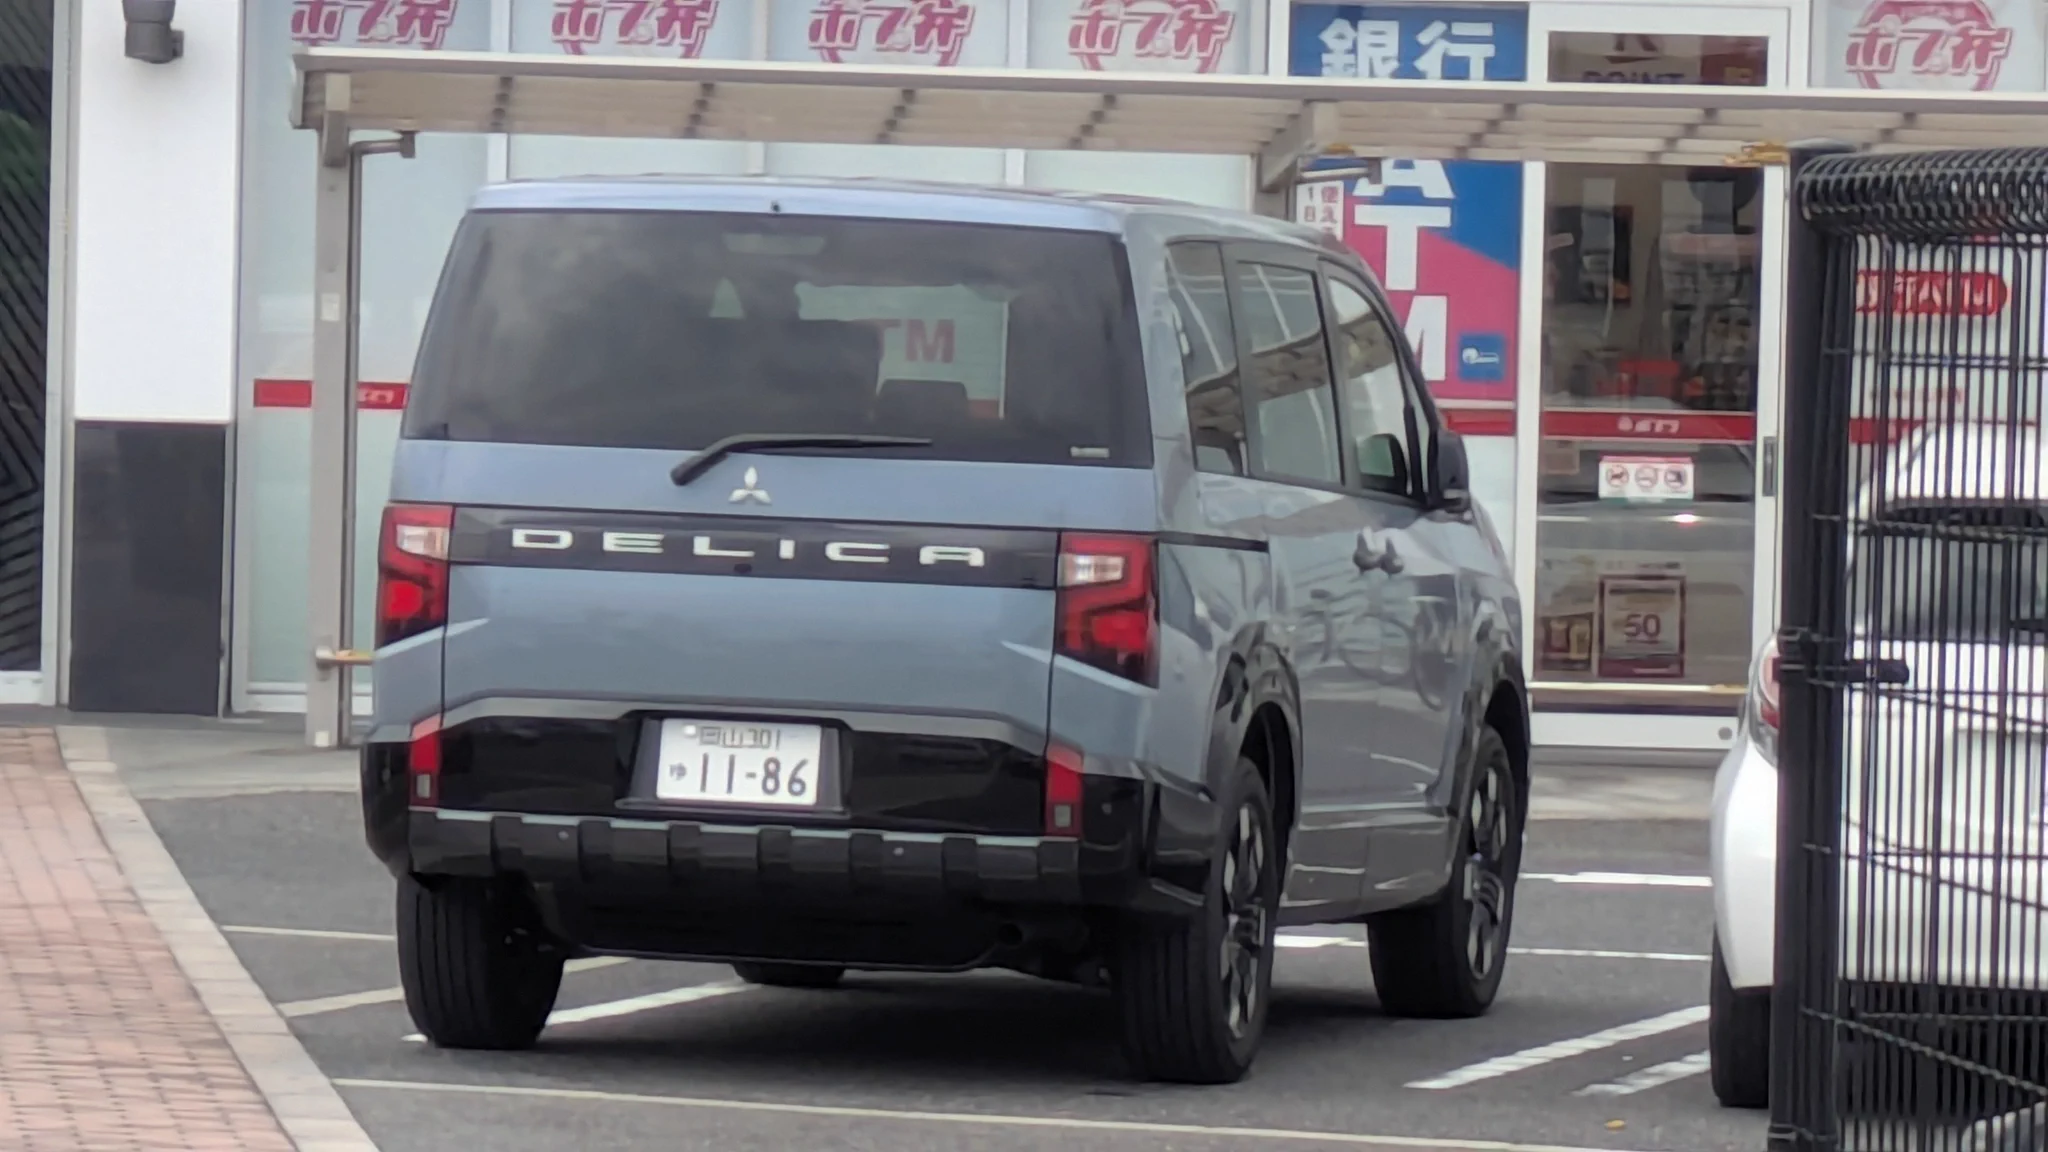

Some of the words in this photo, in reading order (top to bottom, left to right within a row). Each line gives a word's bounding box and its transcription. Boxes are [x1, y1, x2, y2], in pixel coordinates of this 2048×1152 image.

[1318, 17, 1496, 80] 銀行
[512, 528, 985, 567] DELICA
[1624, 612, 1661, 637] 50
[700, 752, 808, 796] 11-86
